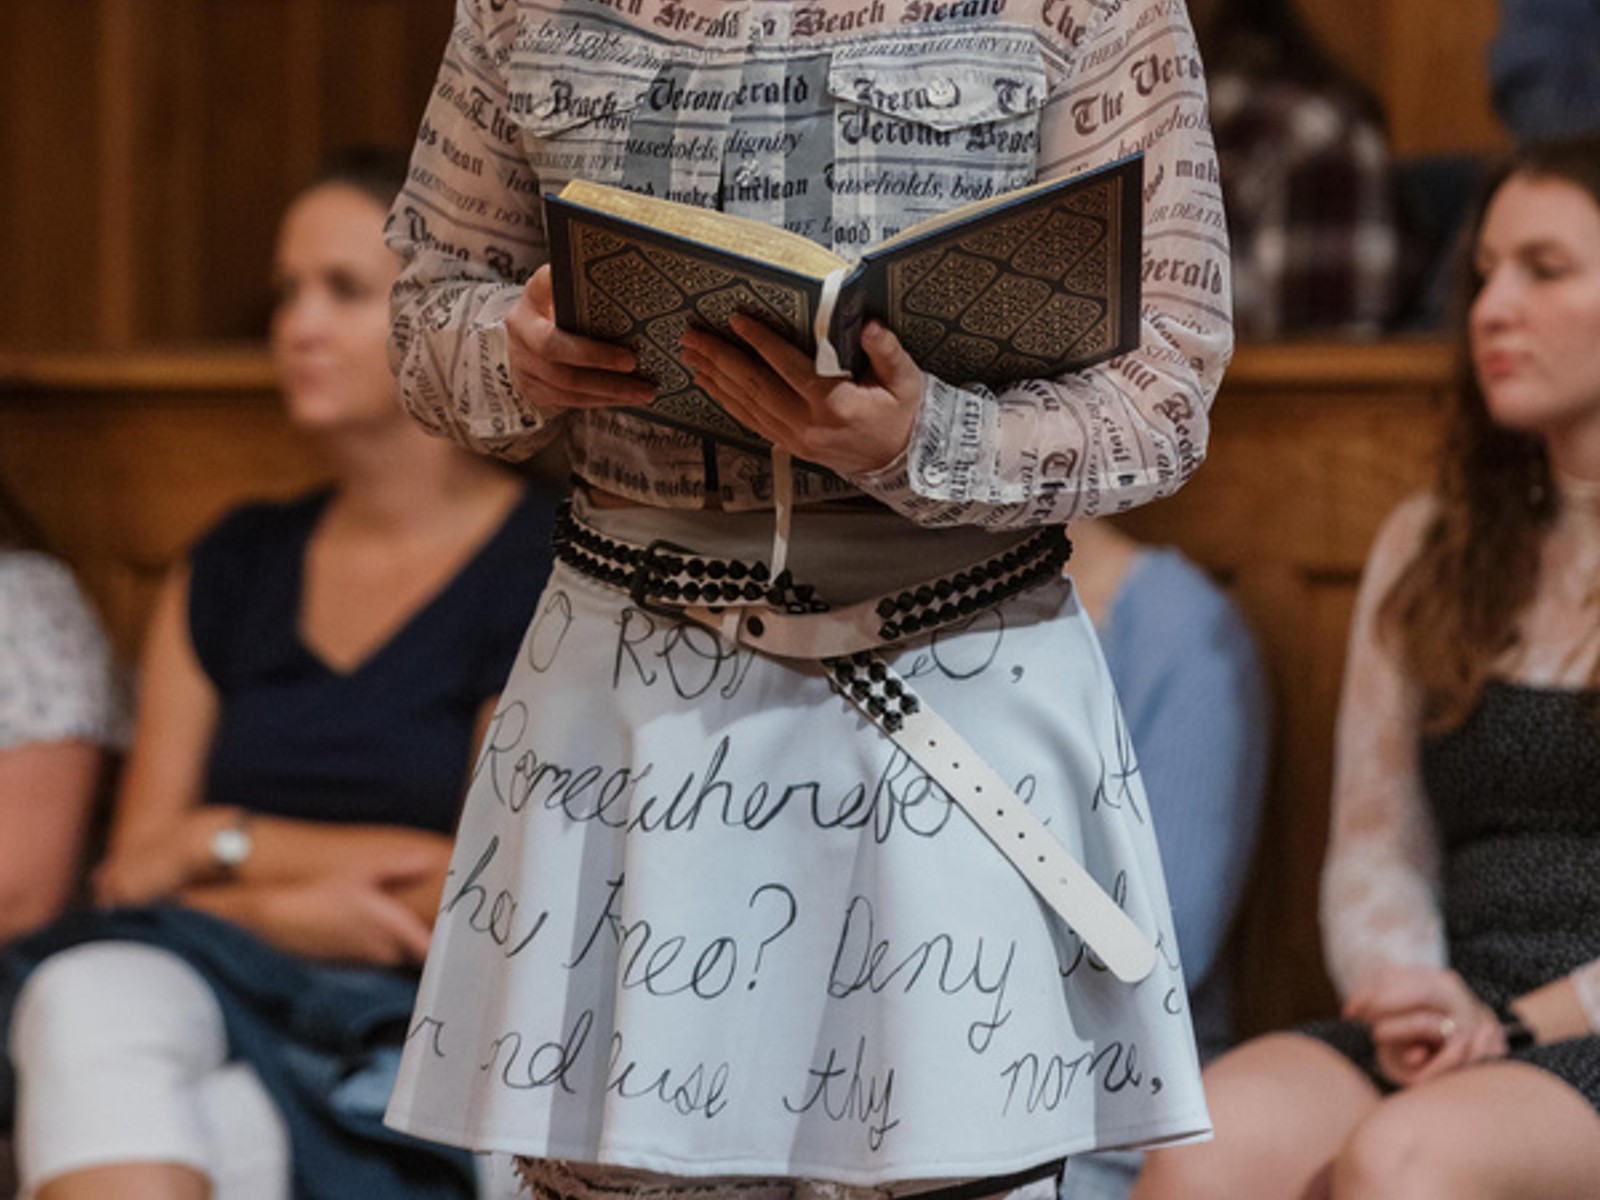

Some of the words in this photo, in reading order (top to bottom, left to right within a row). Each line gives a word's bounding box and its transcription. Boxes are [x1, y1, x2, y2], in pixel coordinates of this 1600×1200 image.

[469, 84, 521, 145] The
[1070, 91, 1125, 137] The
[529, 590, 574, 674] O
[827, 895, 1012, 1054] Deny
[782, 1036, 900, 1152] thy
